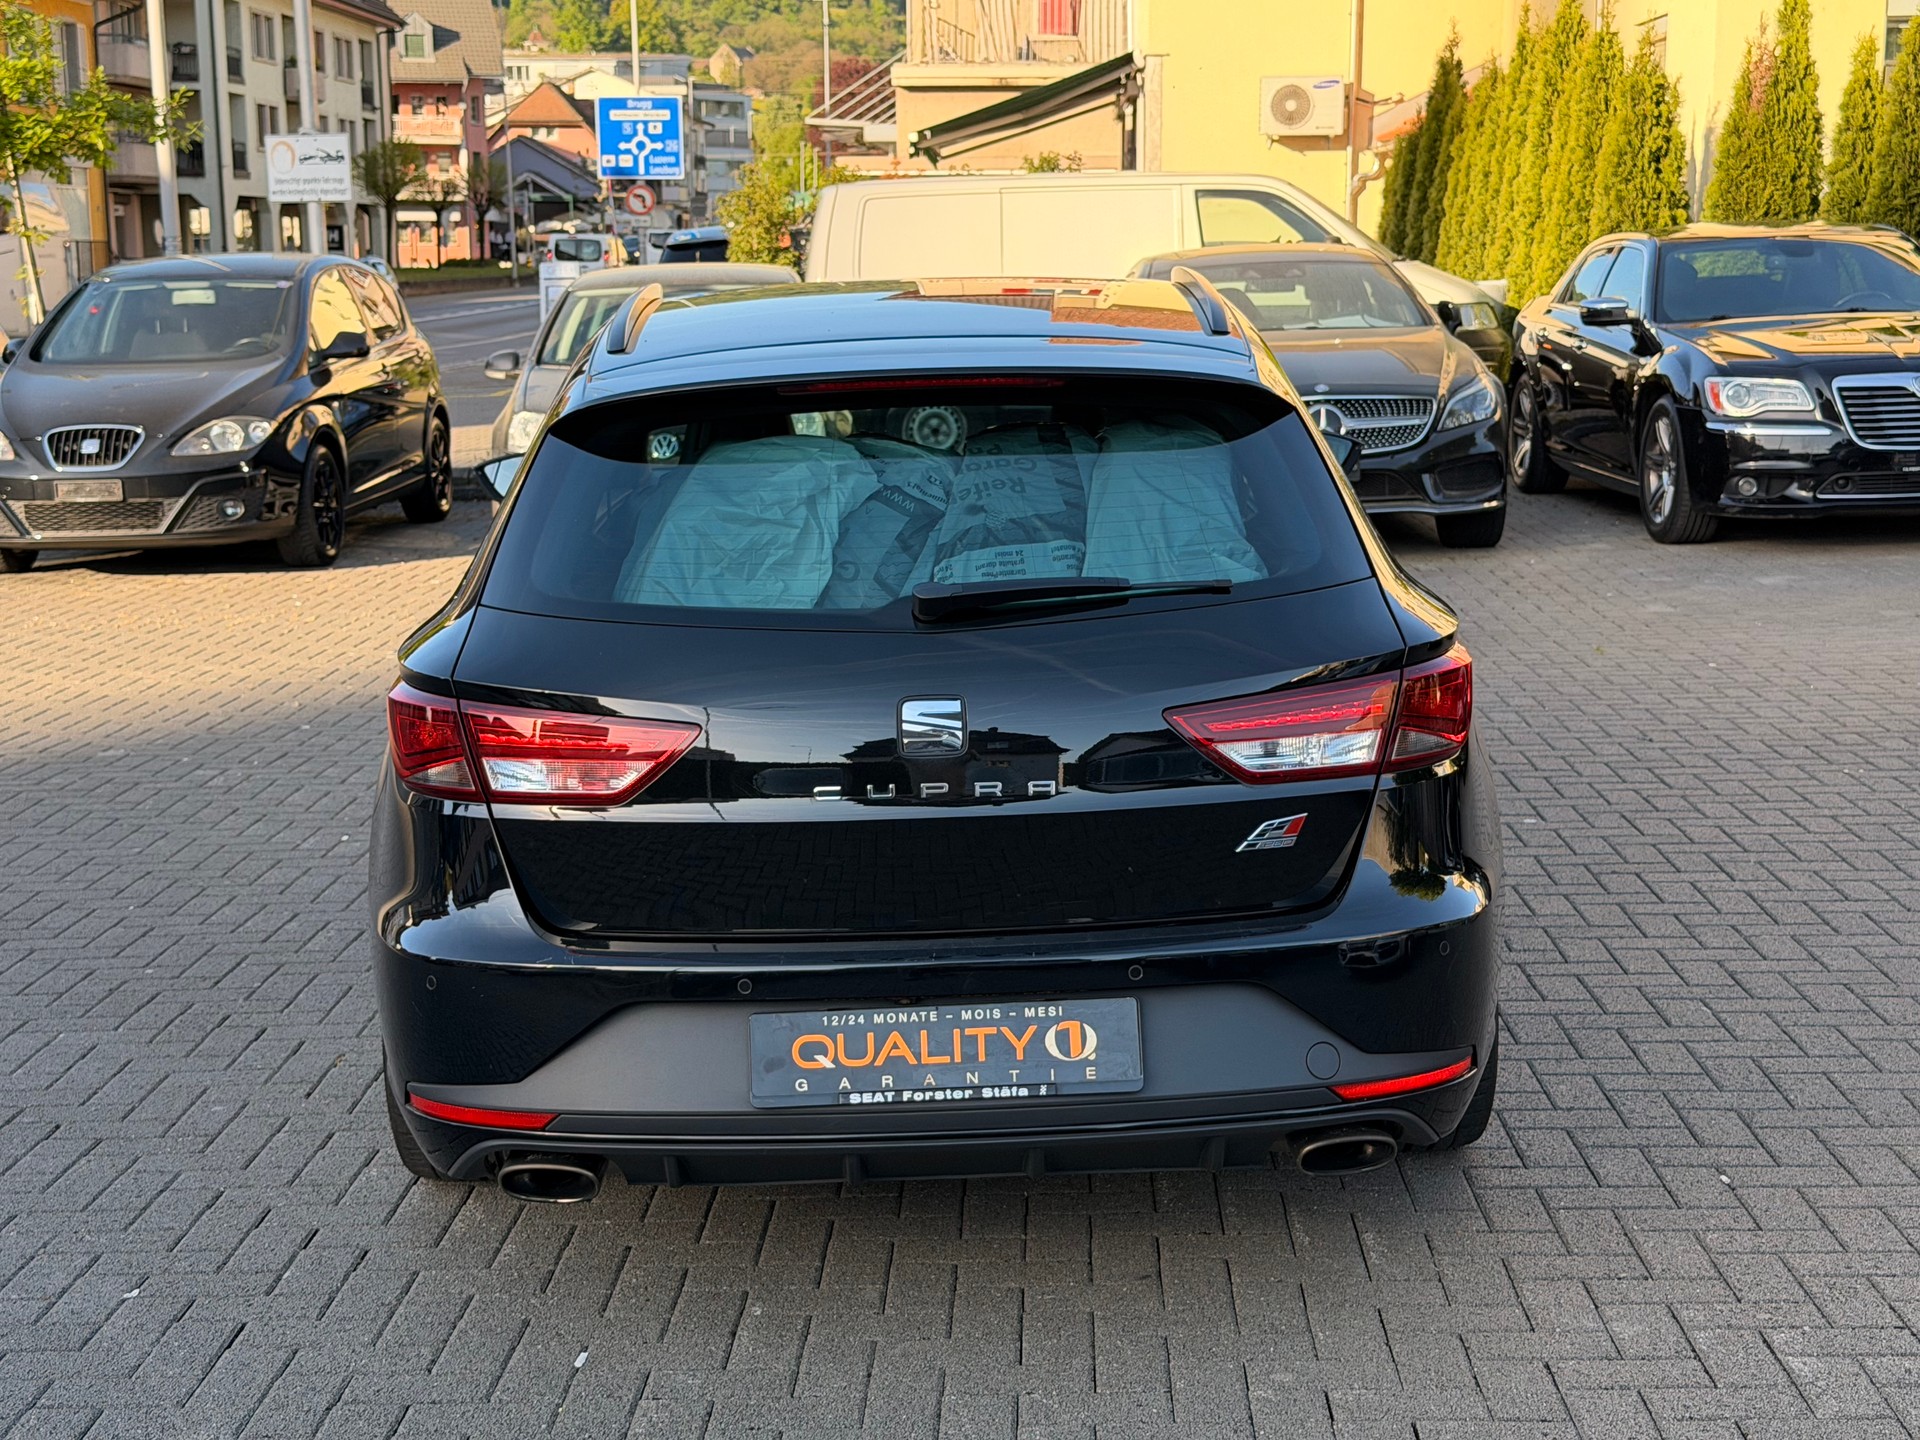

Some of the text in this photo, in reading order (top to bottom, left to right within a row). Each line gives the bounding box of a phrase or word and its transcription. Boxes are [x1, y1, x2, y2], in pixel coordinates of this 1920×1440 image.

[813, 780, 1057, 801] CUPRA
[822, 1015, 865, 1027] 12/24
[873, 1011, 938, 1025] MONATE
[961, 1008, 1001, 1021] MOIS
[1024, 1006, 1063, 1018] MESI
[791, 1024, 1038, 1070] QUALITY
[794, 1066, 1097, 1092] GARANTIE
[849, 1085, 1029, 1105] SEAT Forster Stäfa
